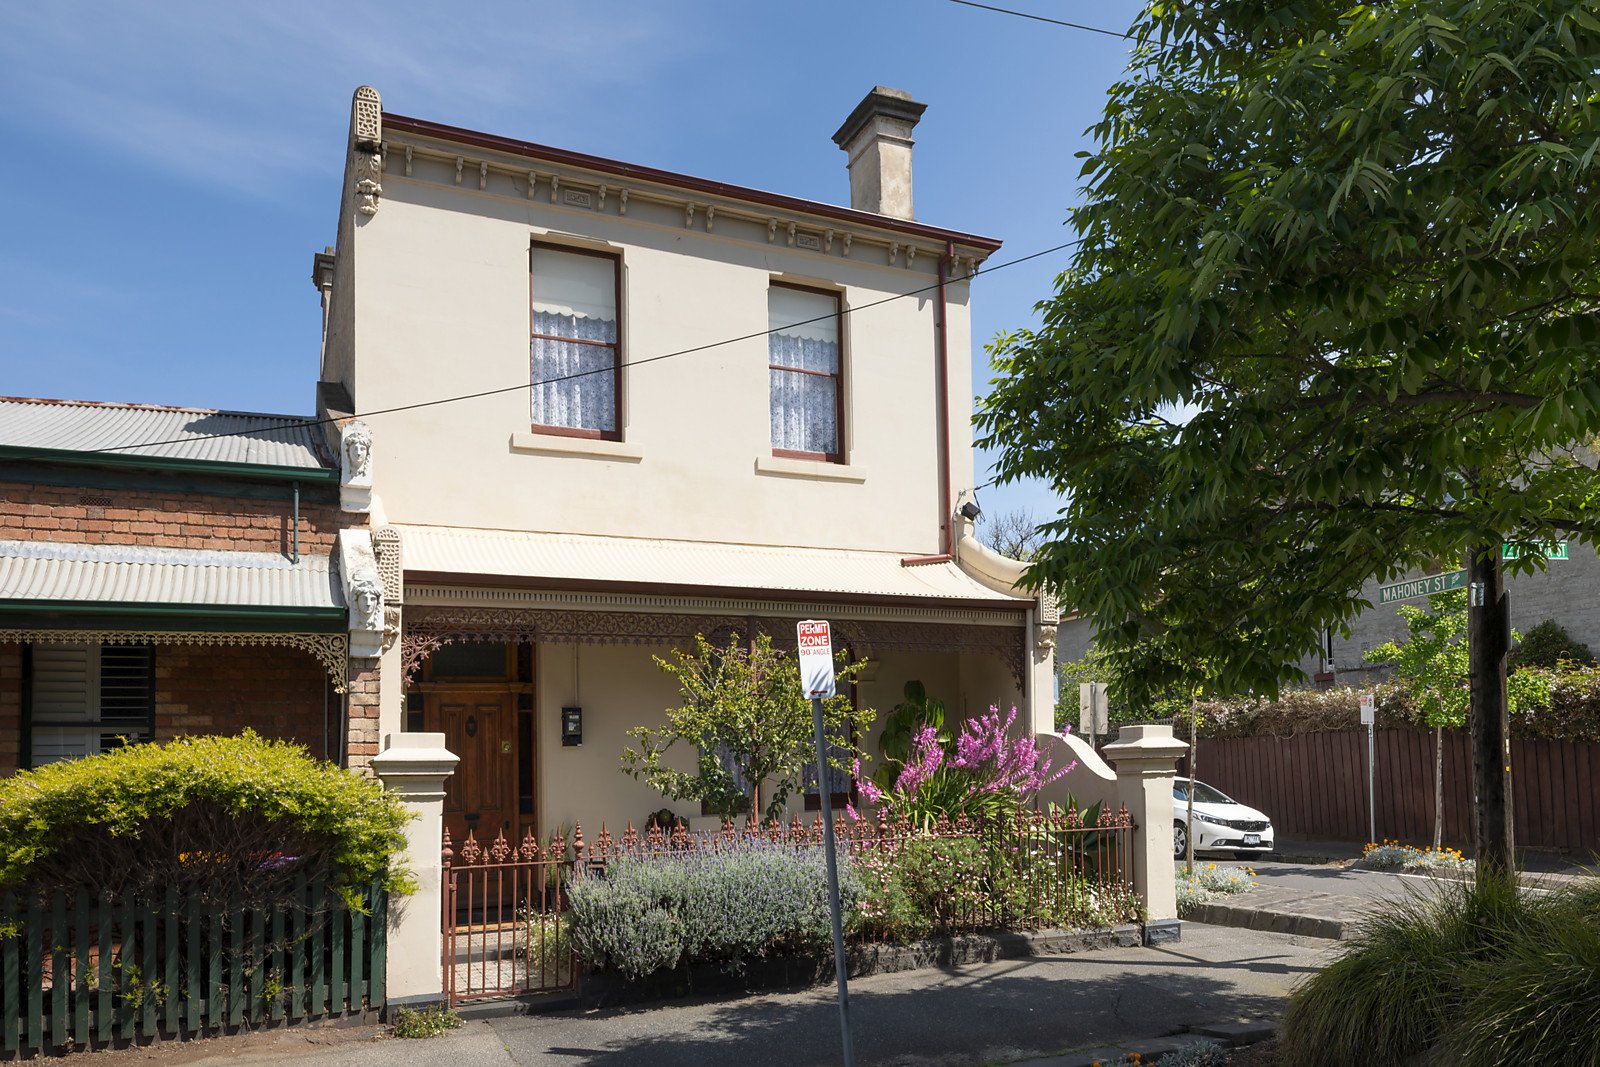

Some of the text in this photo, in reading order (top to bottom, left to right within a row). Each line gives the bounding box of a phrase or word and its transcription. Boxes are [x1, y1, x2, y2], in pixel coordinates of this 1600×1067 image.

[1383, 575, 1447, 601] MAHONEY ST
[800, 623, 827, 634] PERMIT
[801, 635, 828, 646] ZONE
